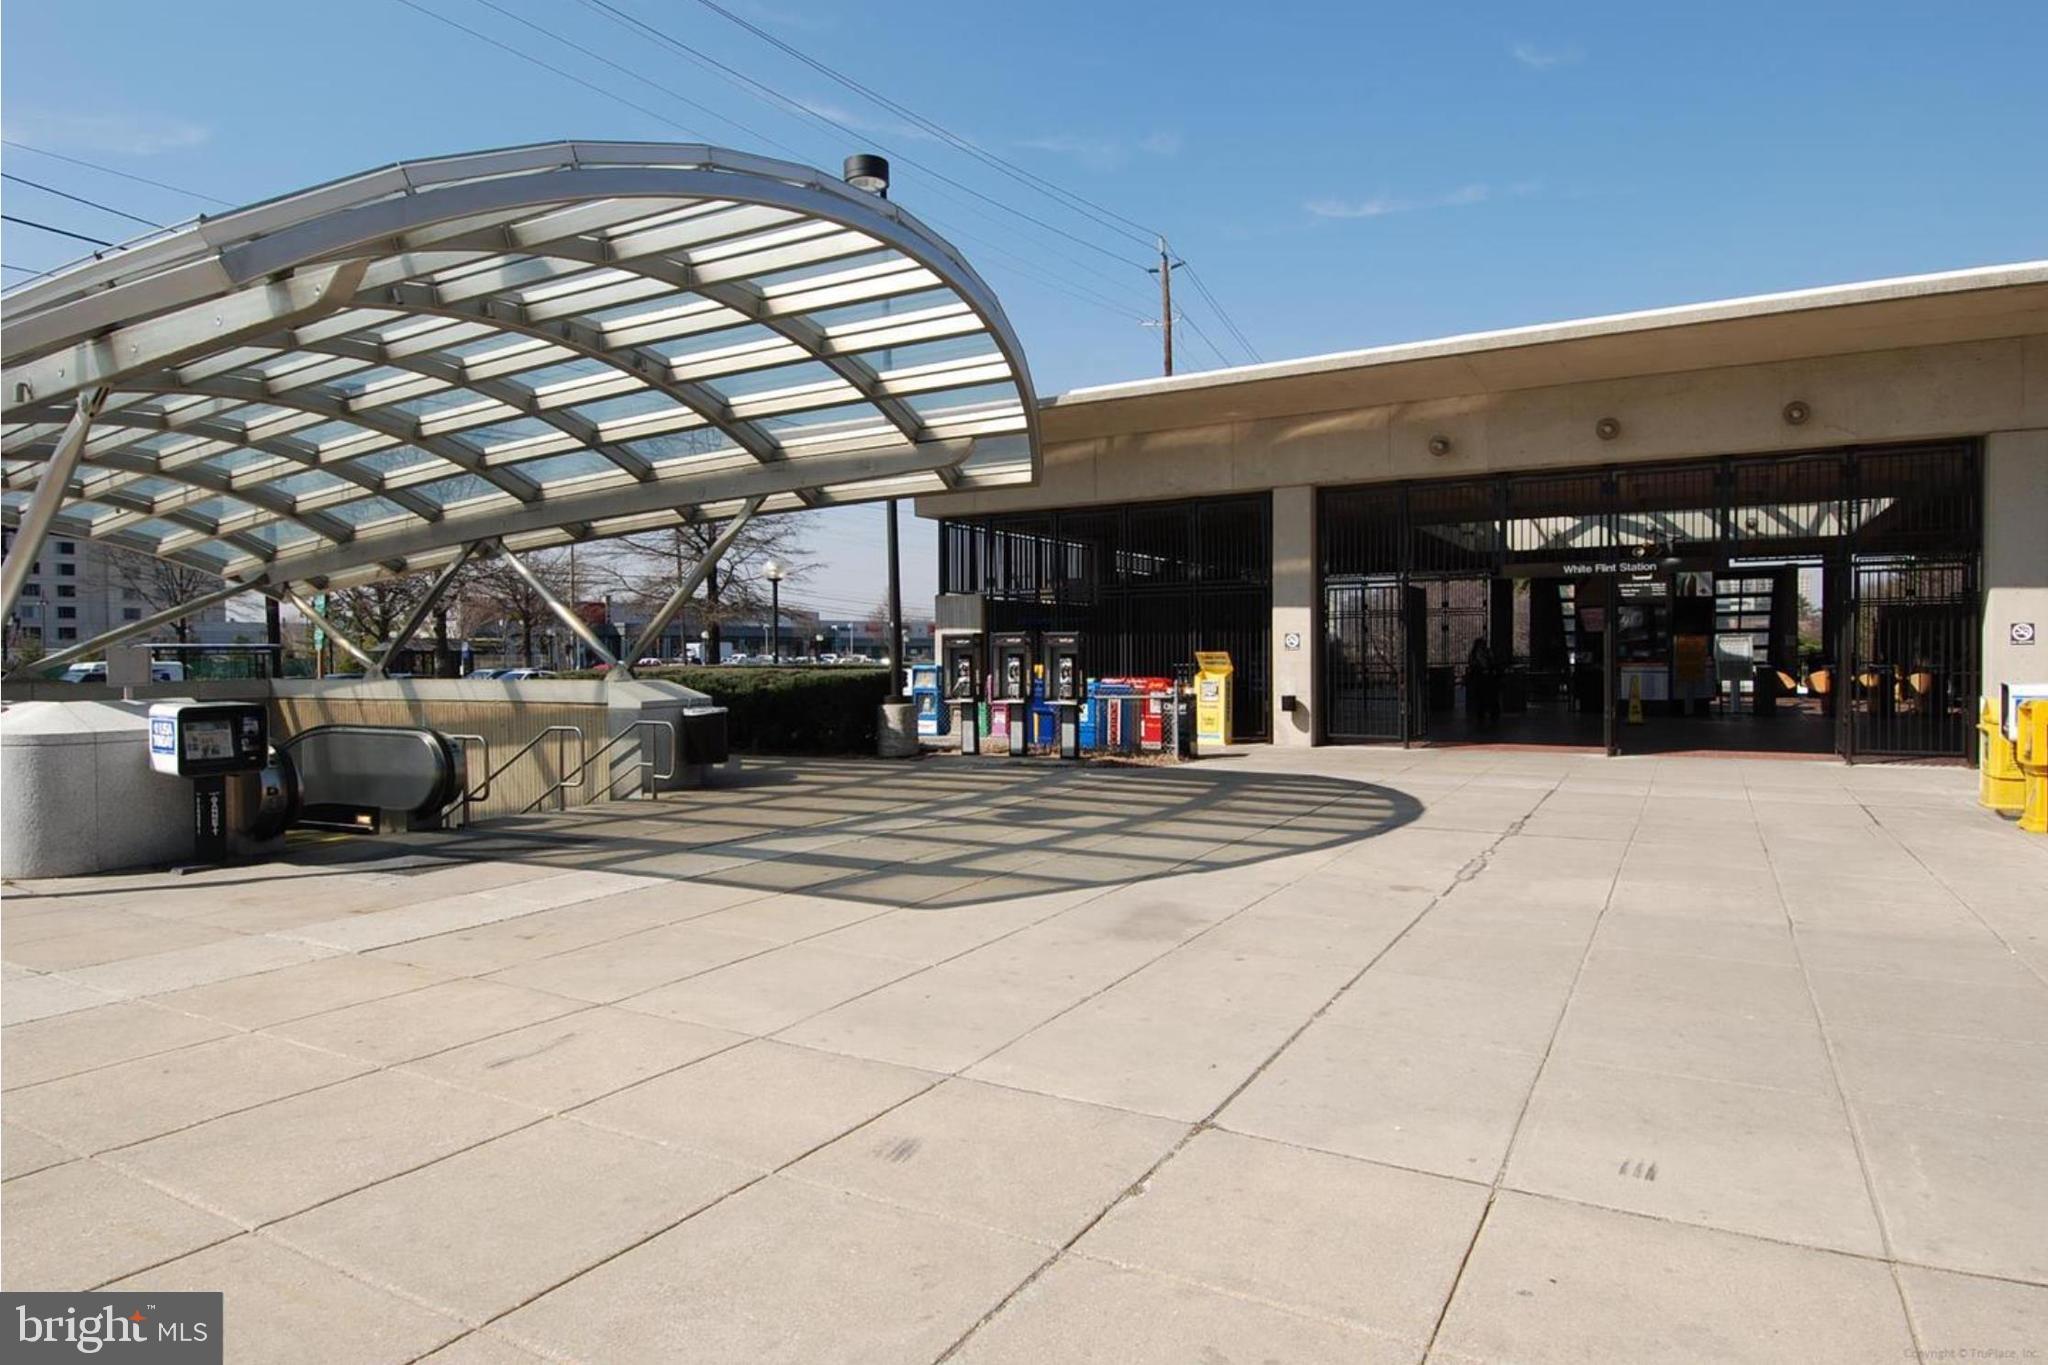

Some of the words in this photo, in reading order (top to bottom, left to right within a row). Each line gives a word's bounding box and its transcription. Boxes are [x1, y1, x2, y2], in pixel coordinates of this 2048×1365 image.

[1563, 564, 1593, 575] White
[1595, 563, 1616, 573] Flint
[1619, 562, 1657, 572] Station
